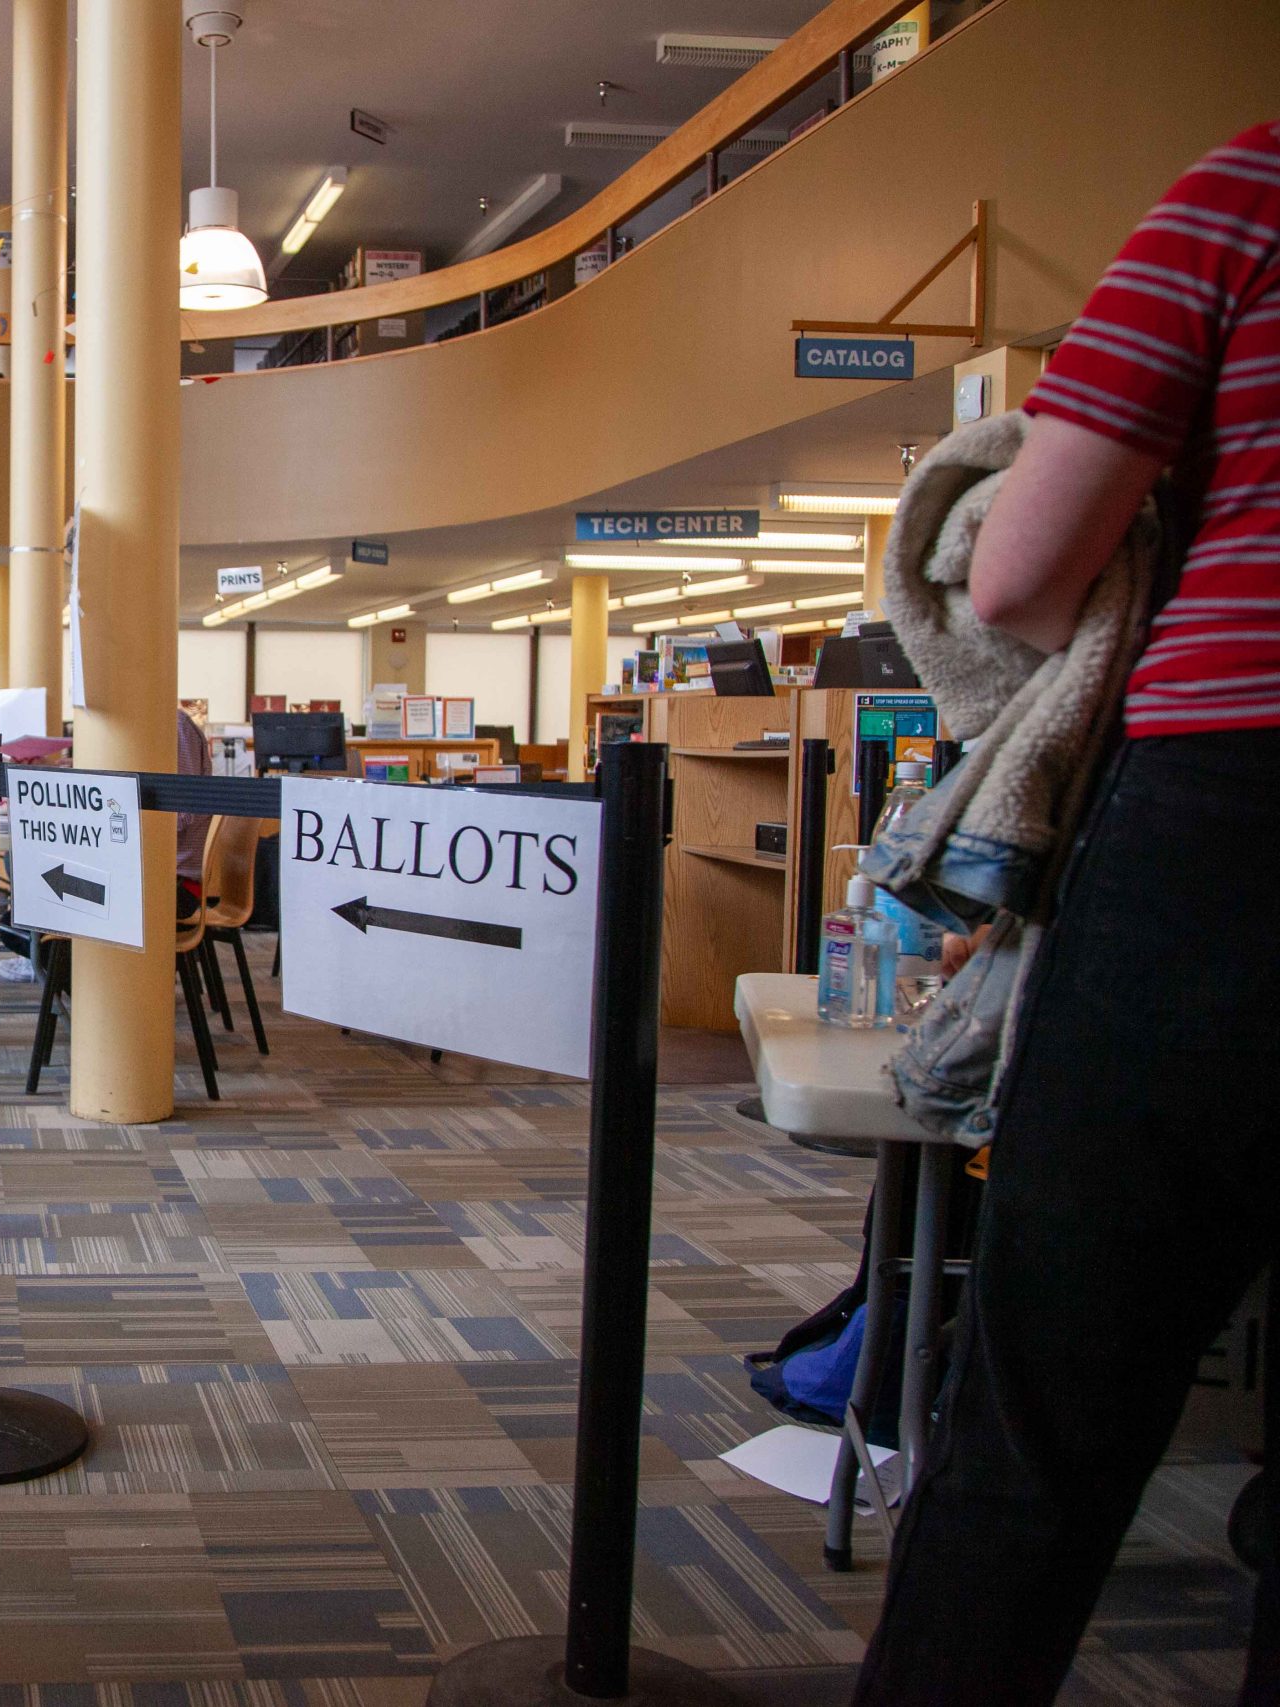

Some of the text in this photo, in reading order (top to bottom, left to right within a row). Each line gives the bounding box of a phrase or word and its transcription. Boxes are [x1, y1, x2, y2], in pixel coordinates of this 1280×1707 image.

[376, 262, 410, 270] MYSTERY
[806, 348, 905, 367] CATALOG
[590, 515, 744, 535] TECH CENTER
[220, 572, 261, 587] PRINTS
[18, 780, 103, 812] POLLING
[19, 819, 102, 848] THIS WAY
[291, 808, 578, 896] BALLOTS
